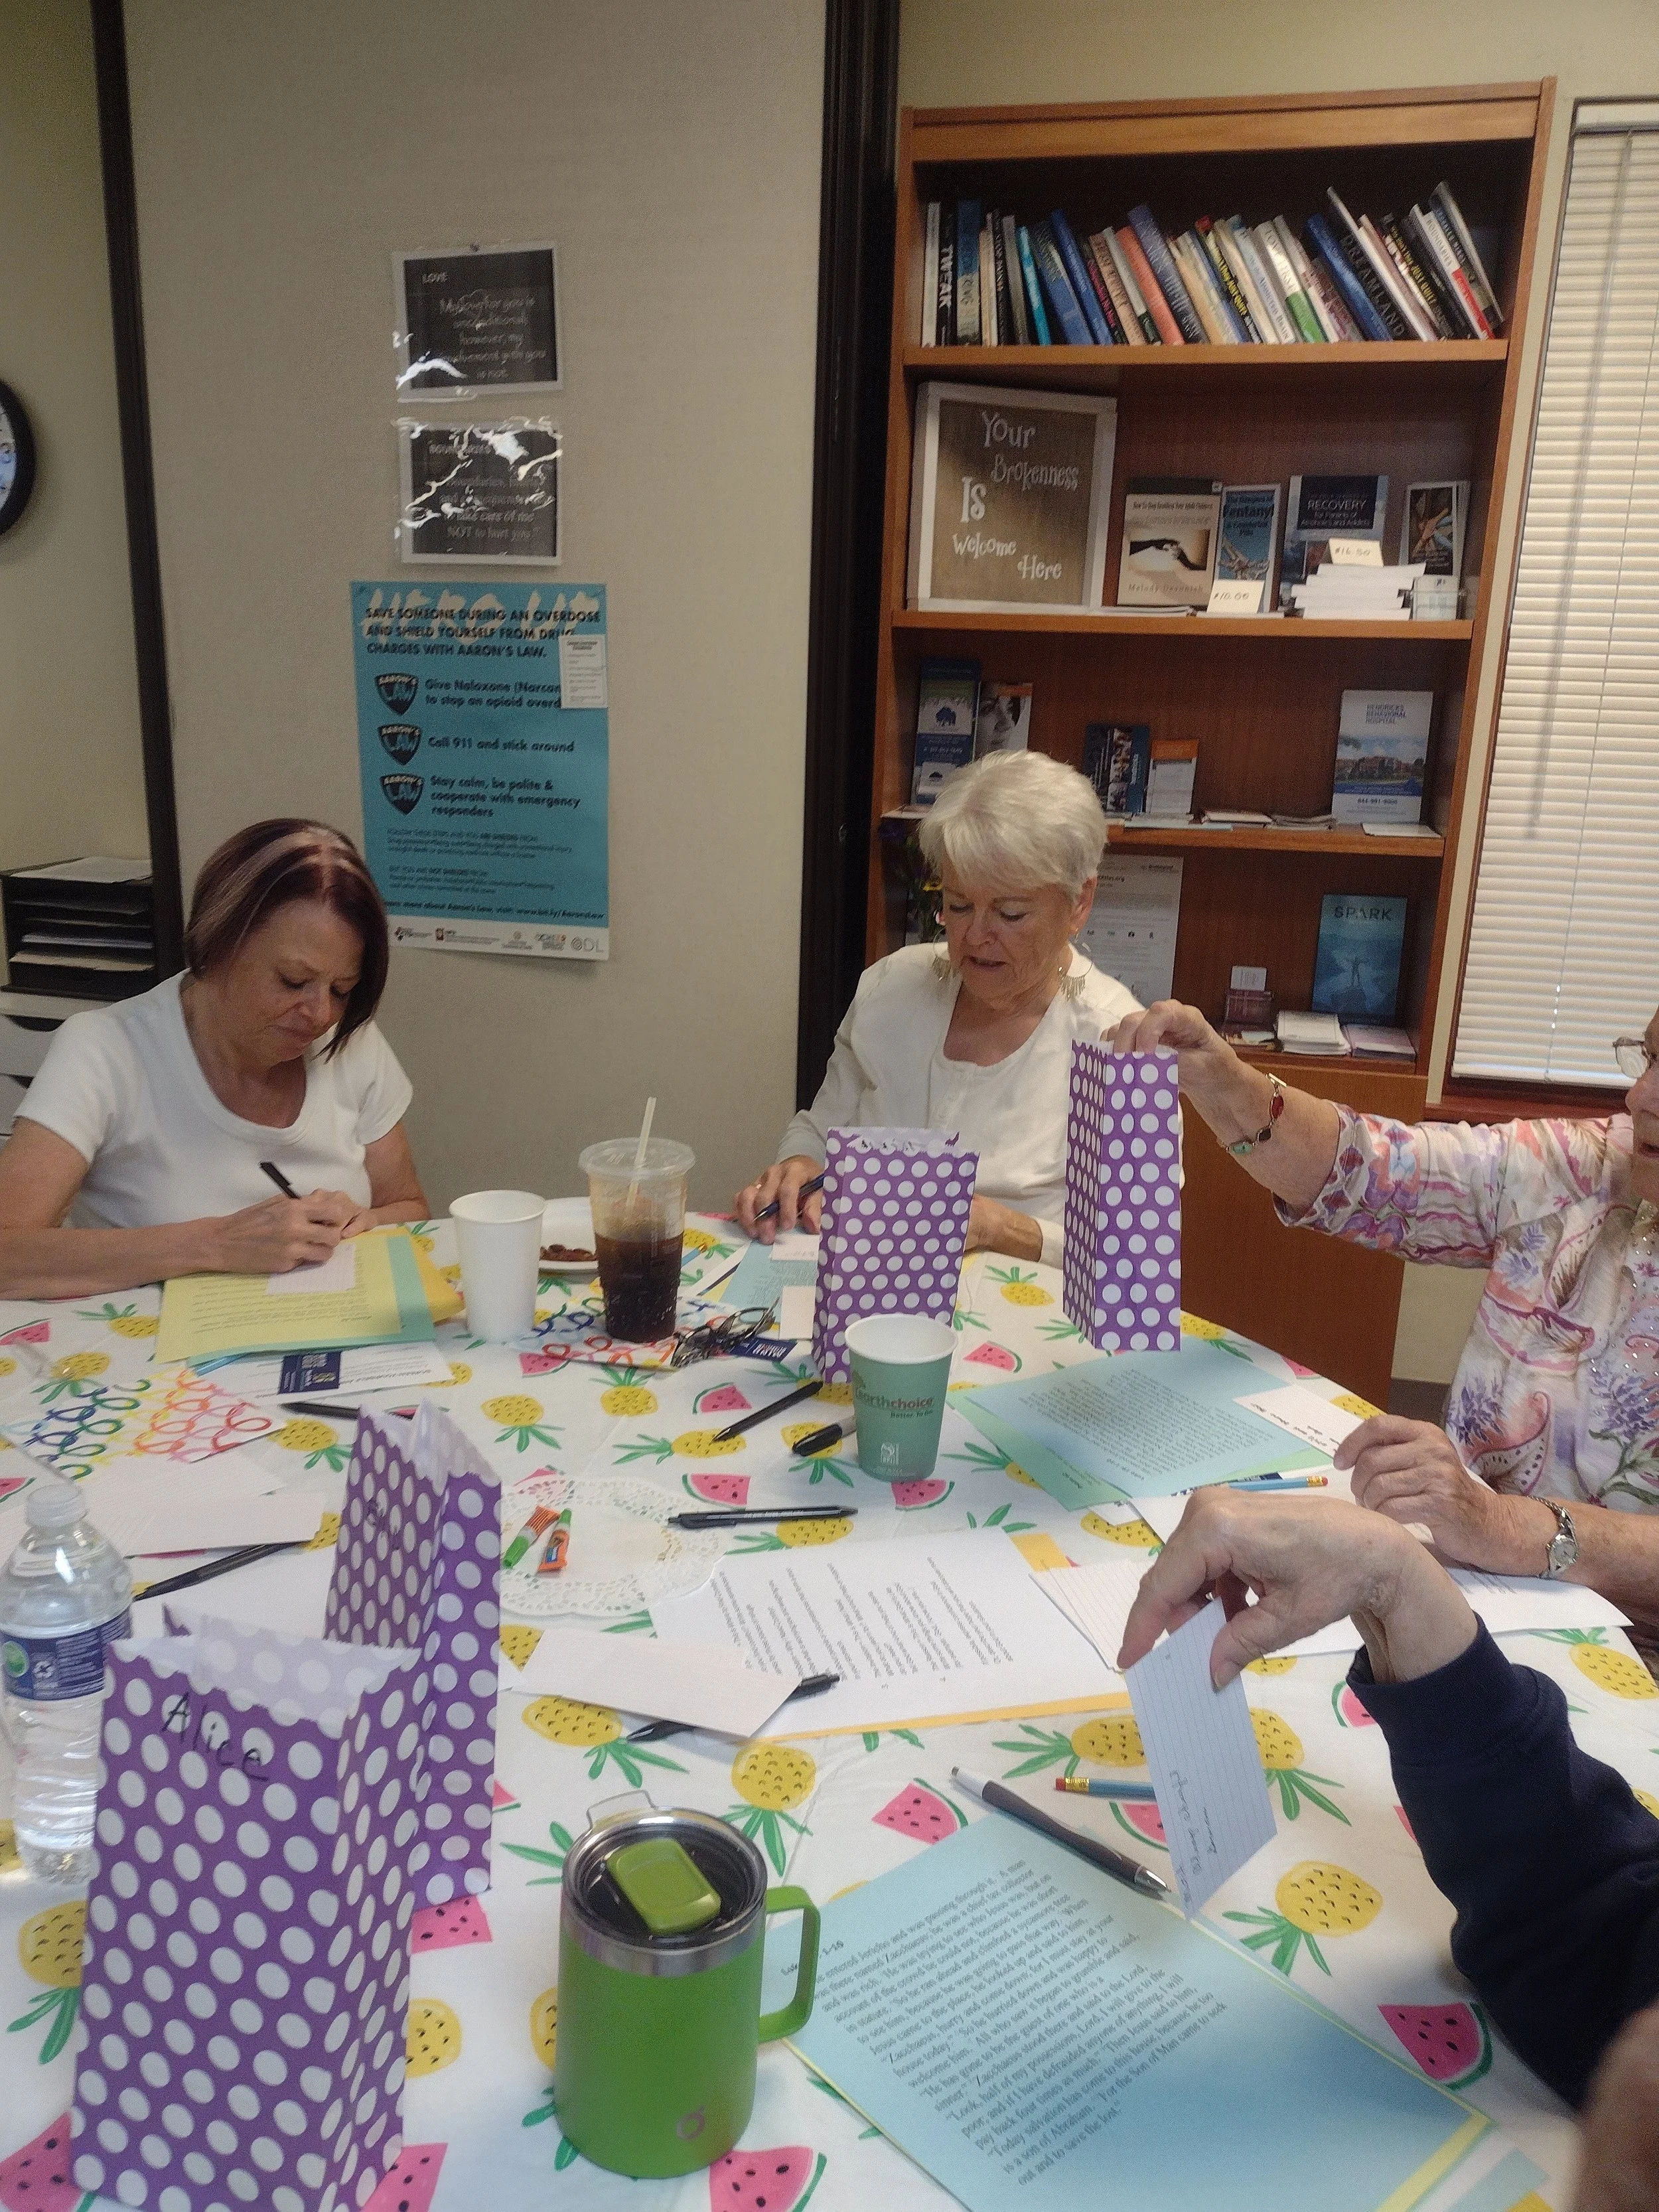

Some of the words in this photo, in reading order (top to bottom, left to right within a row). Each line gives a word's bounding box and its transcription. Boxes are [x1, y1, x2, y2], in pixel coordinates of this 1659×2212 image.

[1426, 219, 1453, 267] BOUNDARIES
[1338, 234, 1405, 336] DREAMLAND
[982, 411, 1035, 449] Your
[991, 454, 1079, 491] Brokenness
[1307, 499, 1367, 510] RECOVERY
[952, 533, 1017, 559] Welcome
[1017, 554, 1062, 581] Here
[366, 608, 393, 619] SAVE
[398, 608, 455, 620] SOMEONE
[459, 609, 506, 621] DURING
[510, 610, 528, 621] AN
[533, 611, 601, 623] OVERDOSE
[366, 626, 393, 636] AND
[396, 627, 434, 637] SHIELD
[438, 627, 496, 638] YOURSELF
[499, 628, 534, 639] FROM
[367, 643, 419, 656] CHARGES
[423, 644, 454, 656] WITH
[457, 645, 514, 657] AARON'S
[517, 646, 548, 658] LAW.
[425, 680, 451, 691] Give
[454, 680, 511, 693] Naloxone
[425, 695, 438, 705] to
[441, 695, 464, 707] stop
[468, 696, 482, 706] an
[486, 696, 523, 708] opioid
[527, 696, 561, 709] overd
[429, 736, 449, 747] Call
[453, 737, 473, 749] 911
[476, 739, 500, 750] and
[502, 740, 528, 751] stick
[532, 741, 575, 753] around
[431, 776, 456, 789] Stay
[459, 777, 488, 790] calm,
[492, 777, 505, 789] be
[508, 778, 542, 792] polite
[544, 779, 554, 791] &
[431, 792, 486, 804] cooperate
[492, 792, 514, 804] with
[518, 795, 581, 809] emergency
[431, 804, 494, 818] responders
[1334, 905, 1393, 922] SPARK
